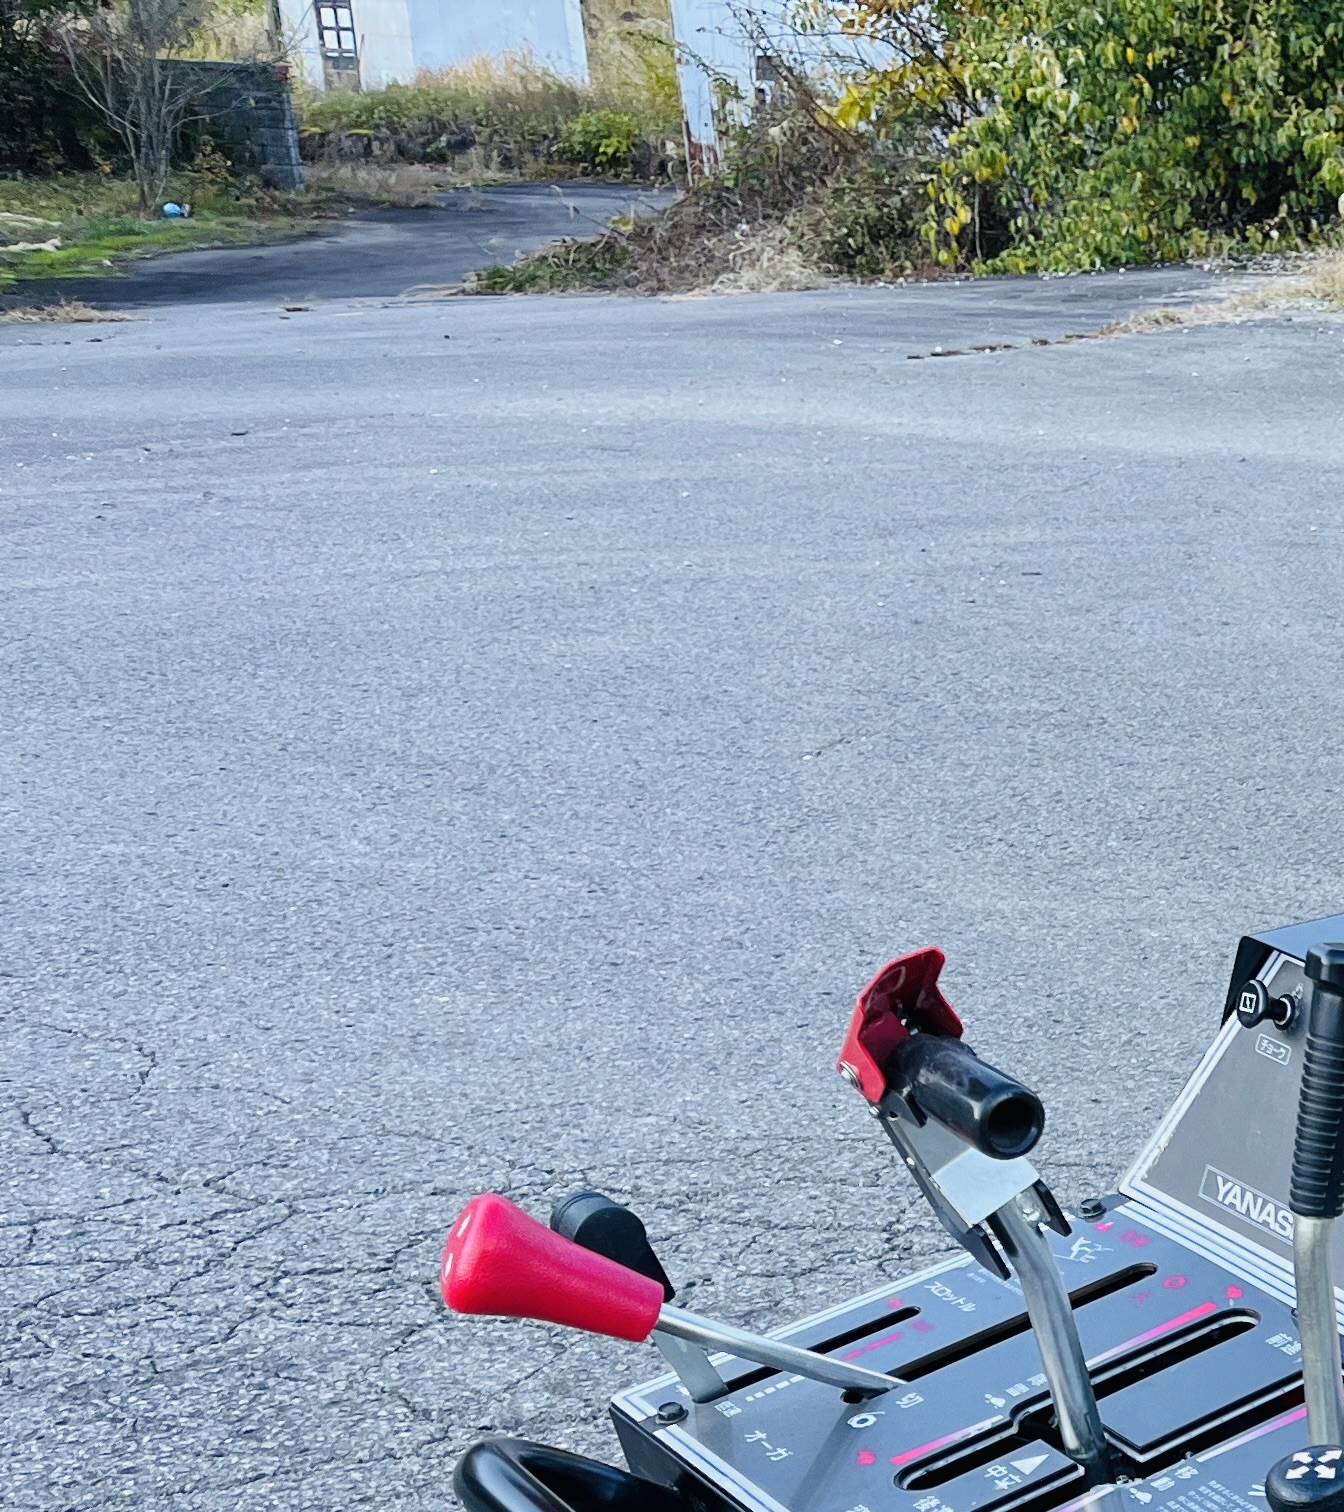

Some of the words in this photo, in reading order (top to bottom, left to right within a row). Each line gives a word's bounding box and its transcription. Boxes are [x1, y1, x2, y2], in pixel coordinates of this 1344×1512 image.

[1216, 1175, 1294, 1240] YANAS
[923, 1281, 977, 1312] スロットル
[744, 1429, 794, 1461] オーガ
[983, 1464, 1023, 1490] 中立
